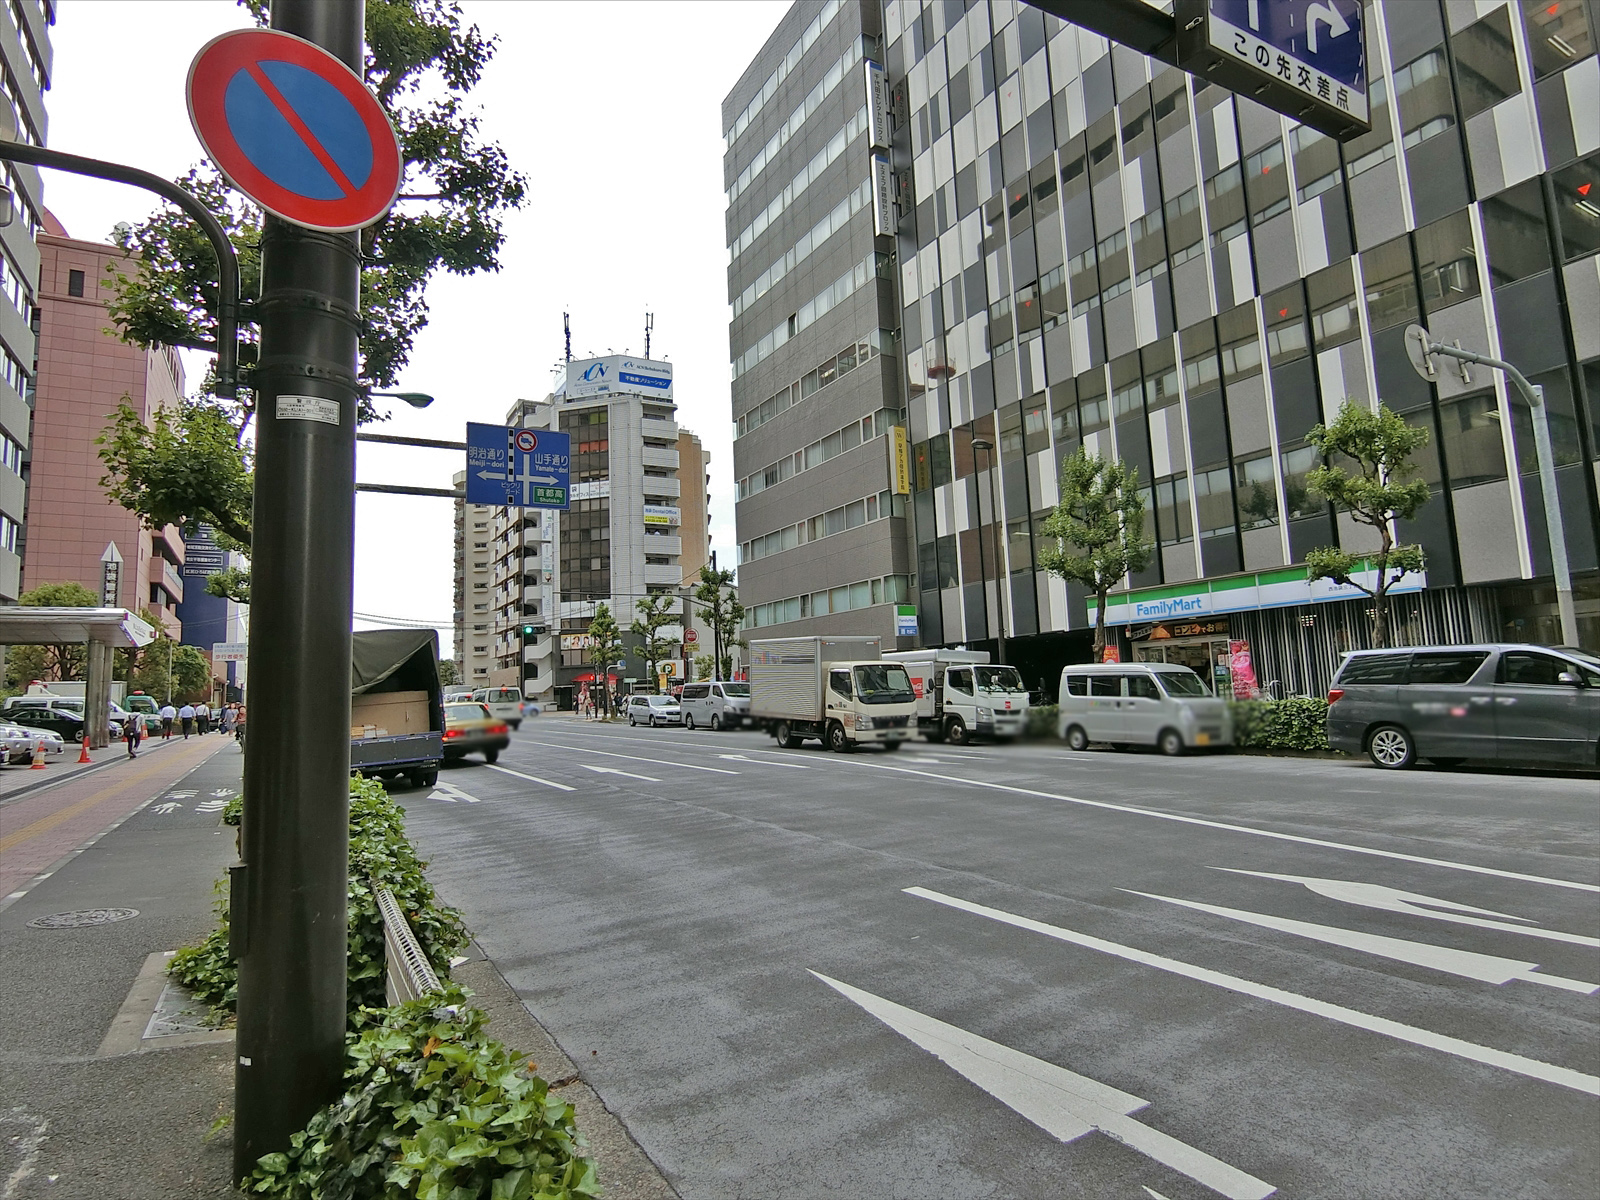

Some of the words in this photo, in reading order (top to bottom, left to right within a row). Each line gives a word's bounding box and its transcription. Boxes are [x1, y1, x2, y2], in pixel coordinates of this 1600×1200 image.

[1234, 32, 1350, 111] この先交差点
[577, 362, 609, 382] ACN
[468, 446, 505, 461] 明治通り
[534, 453, 569, 466] 山手通り
[469, 458, 505, 468] Meiji-dori
[534, 465, 568, 474] Yamate-dori
[536, 488, 563, 498] 首都高
[1136, 597, 1202, 618] FamilyMart
